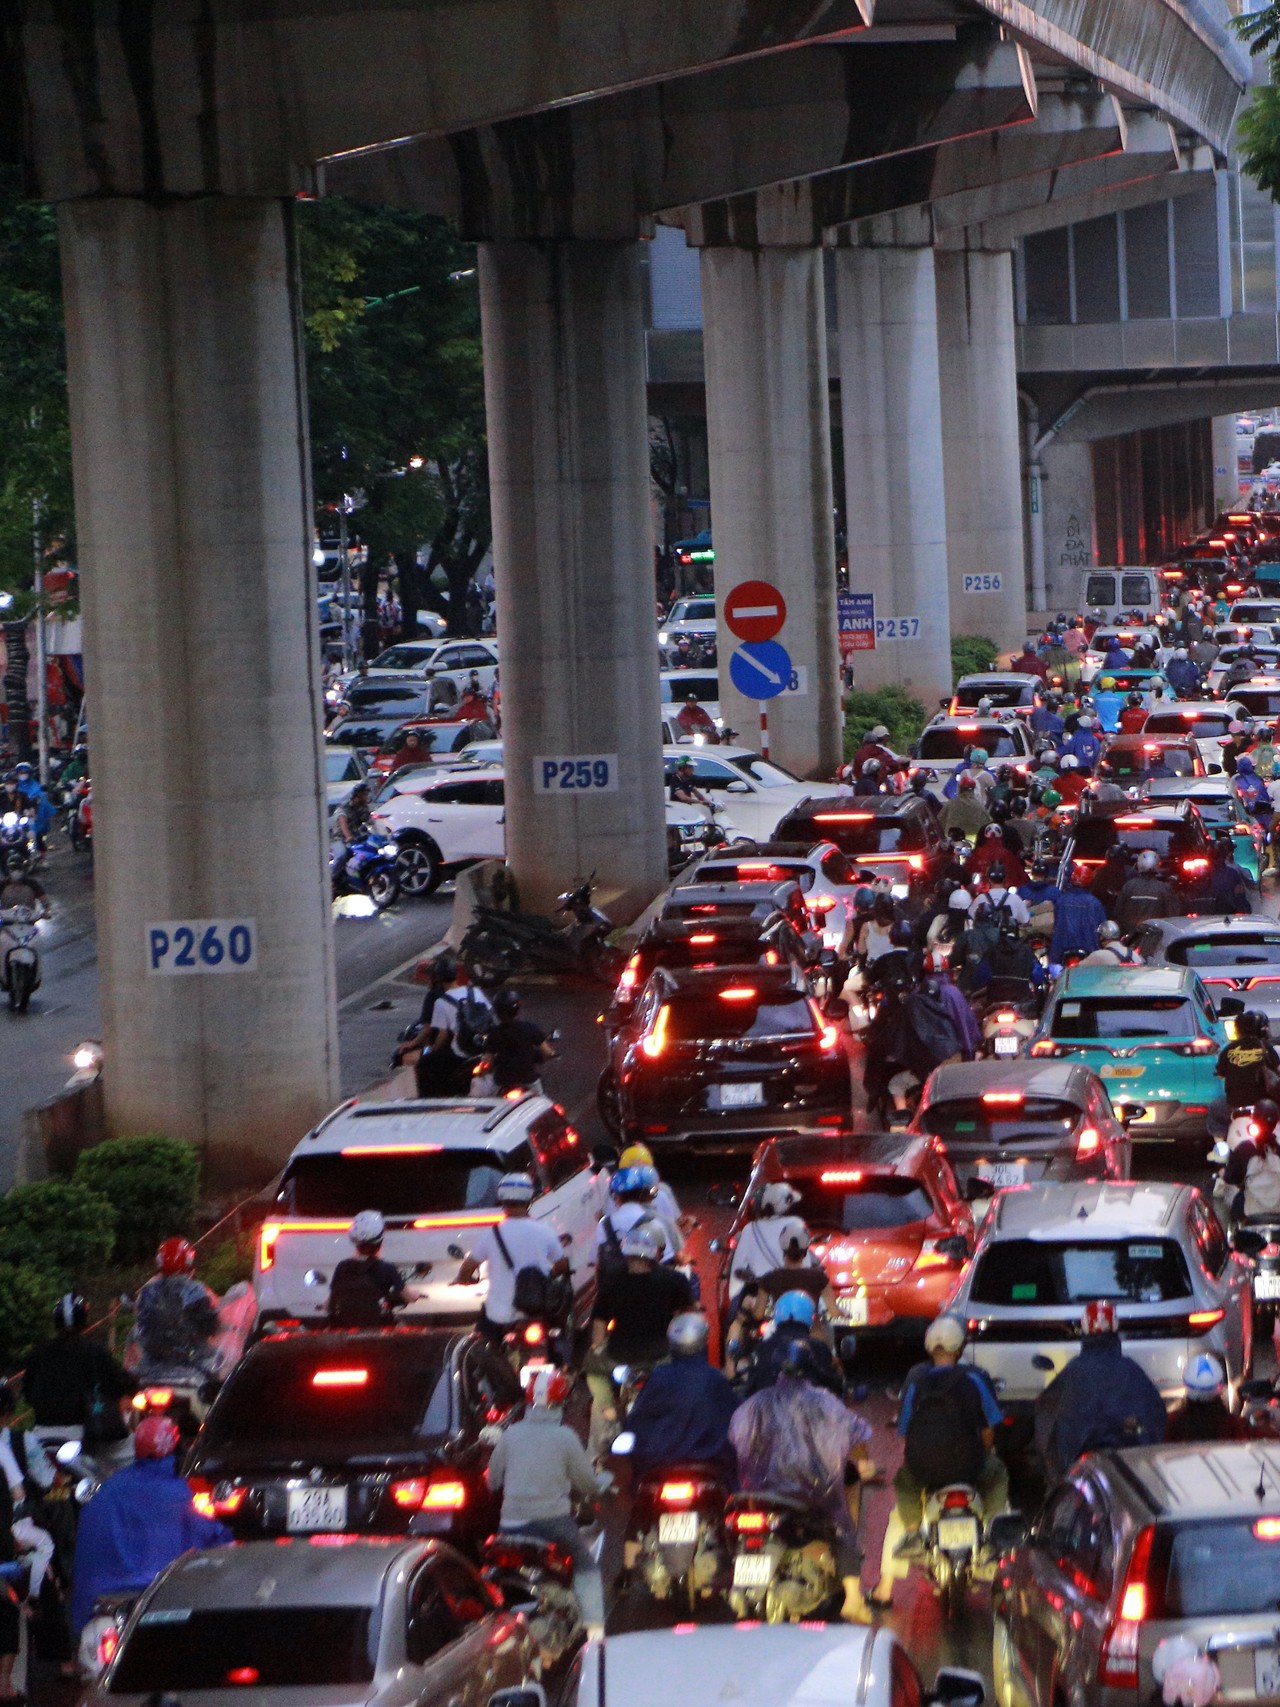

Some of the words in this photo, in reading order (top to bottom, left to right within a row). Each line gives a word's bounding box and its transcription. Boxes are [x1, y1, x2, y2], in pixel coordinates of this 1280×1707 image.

[964, 575, 1000, 590] P256
[842, 618, 872, 630] ANH
[876, 618, 919, 637] P257
[543, 760, 608, 788] P259
[150, 925, 251, 969] P260
